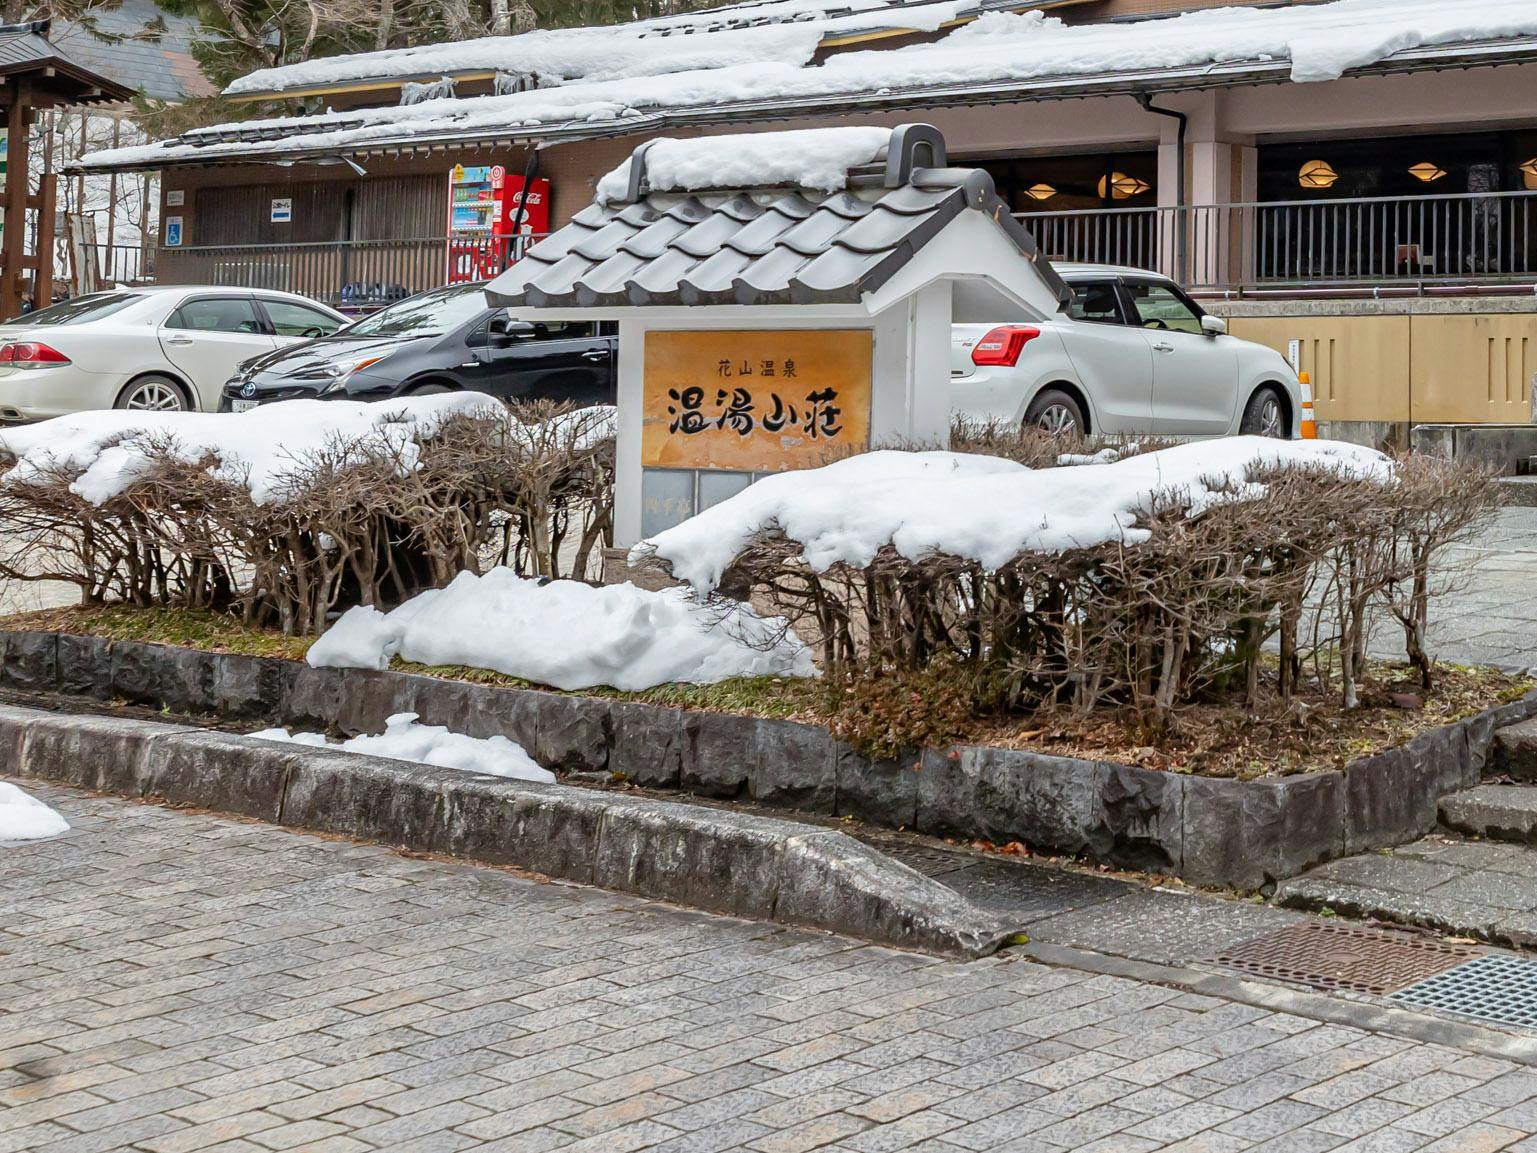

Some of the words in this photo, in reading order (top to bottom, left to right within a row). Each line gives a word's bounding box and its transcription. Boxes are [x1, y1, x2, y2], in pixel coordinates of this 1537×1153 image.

[717, 358, 799, 378] 花山温泉
[667, 387, 843, 438] 温湯山荘
